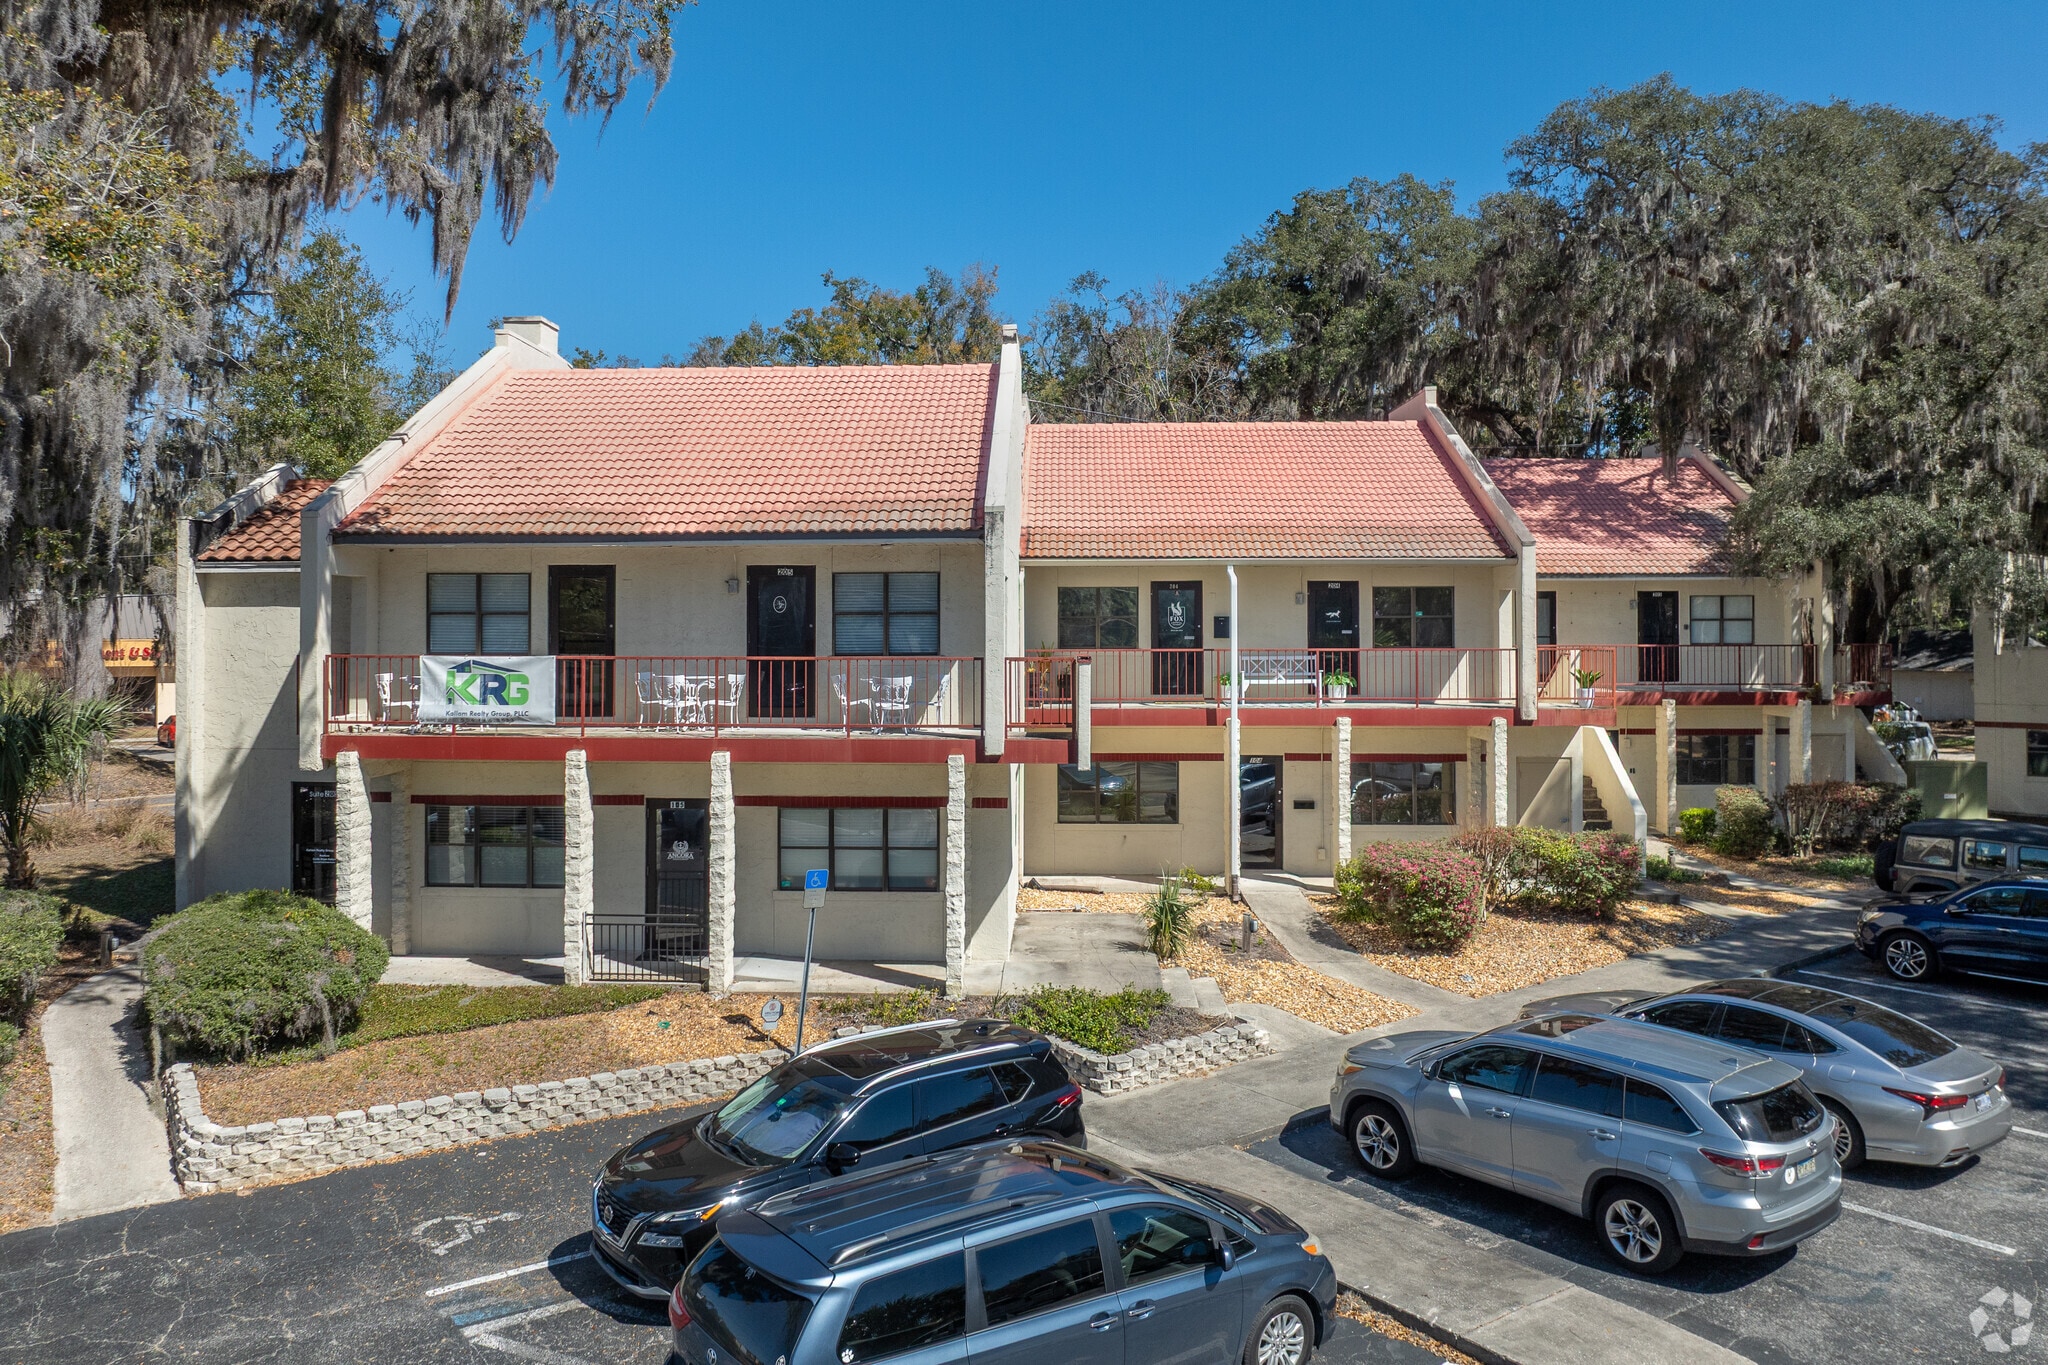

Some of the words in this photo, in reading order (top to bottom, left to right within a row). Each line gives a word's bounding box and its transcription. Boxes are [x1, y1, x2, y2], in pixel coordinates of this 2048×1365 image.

[446, 670, 530, 706] KRG
[469, 710, 489, 718] Realty
[490, 710, 513, 718] Group,
[309, 790, 325, 798] Suite
